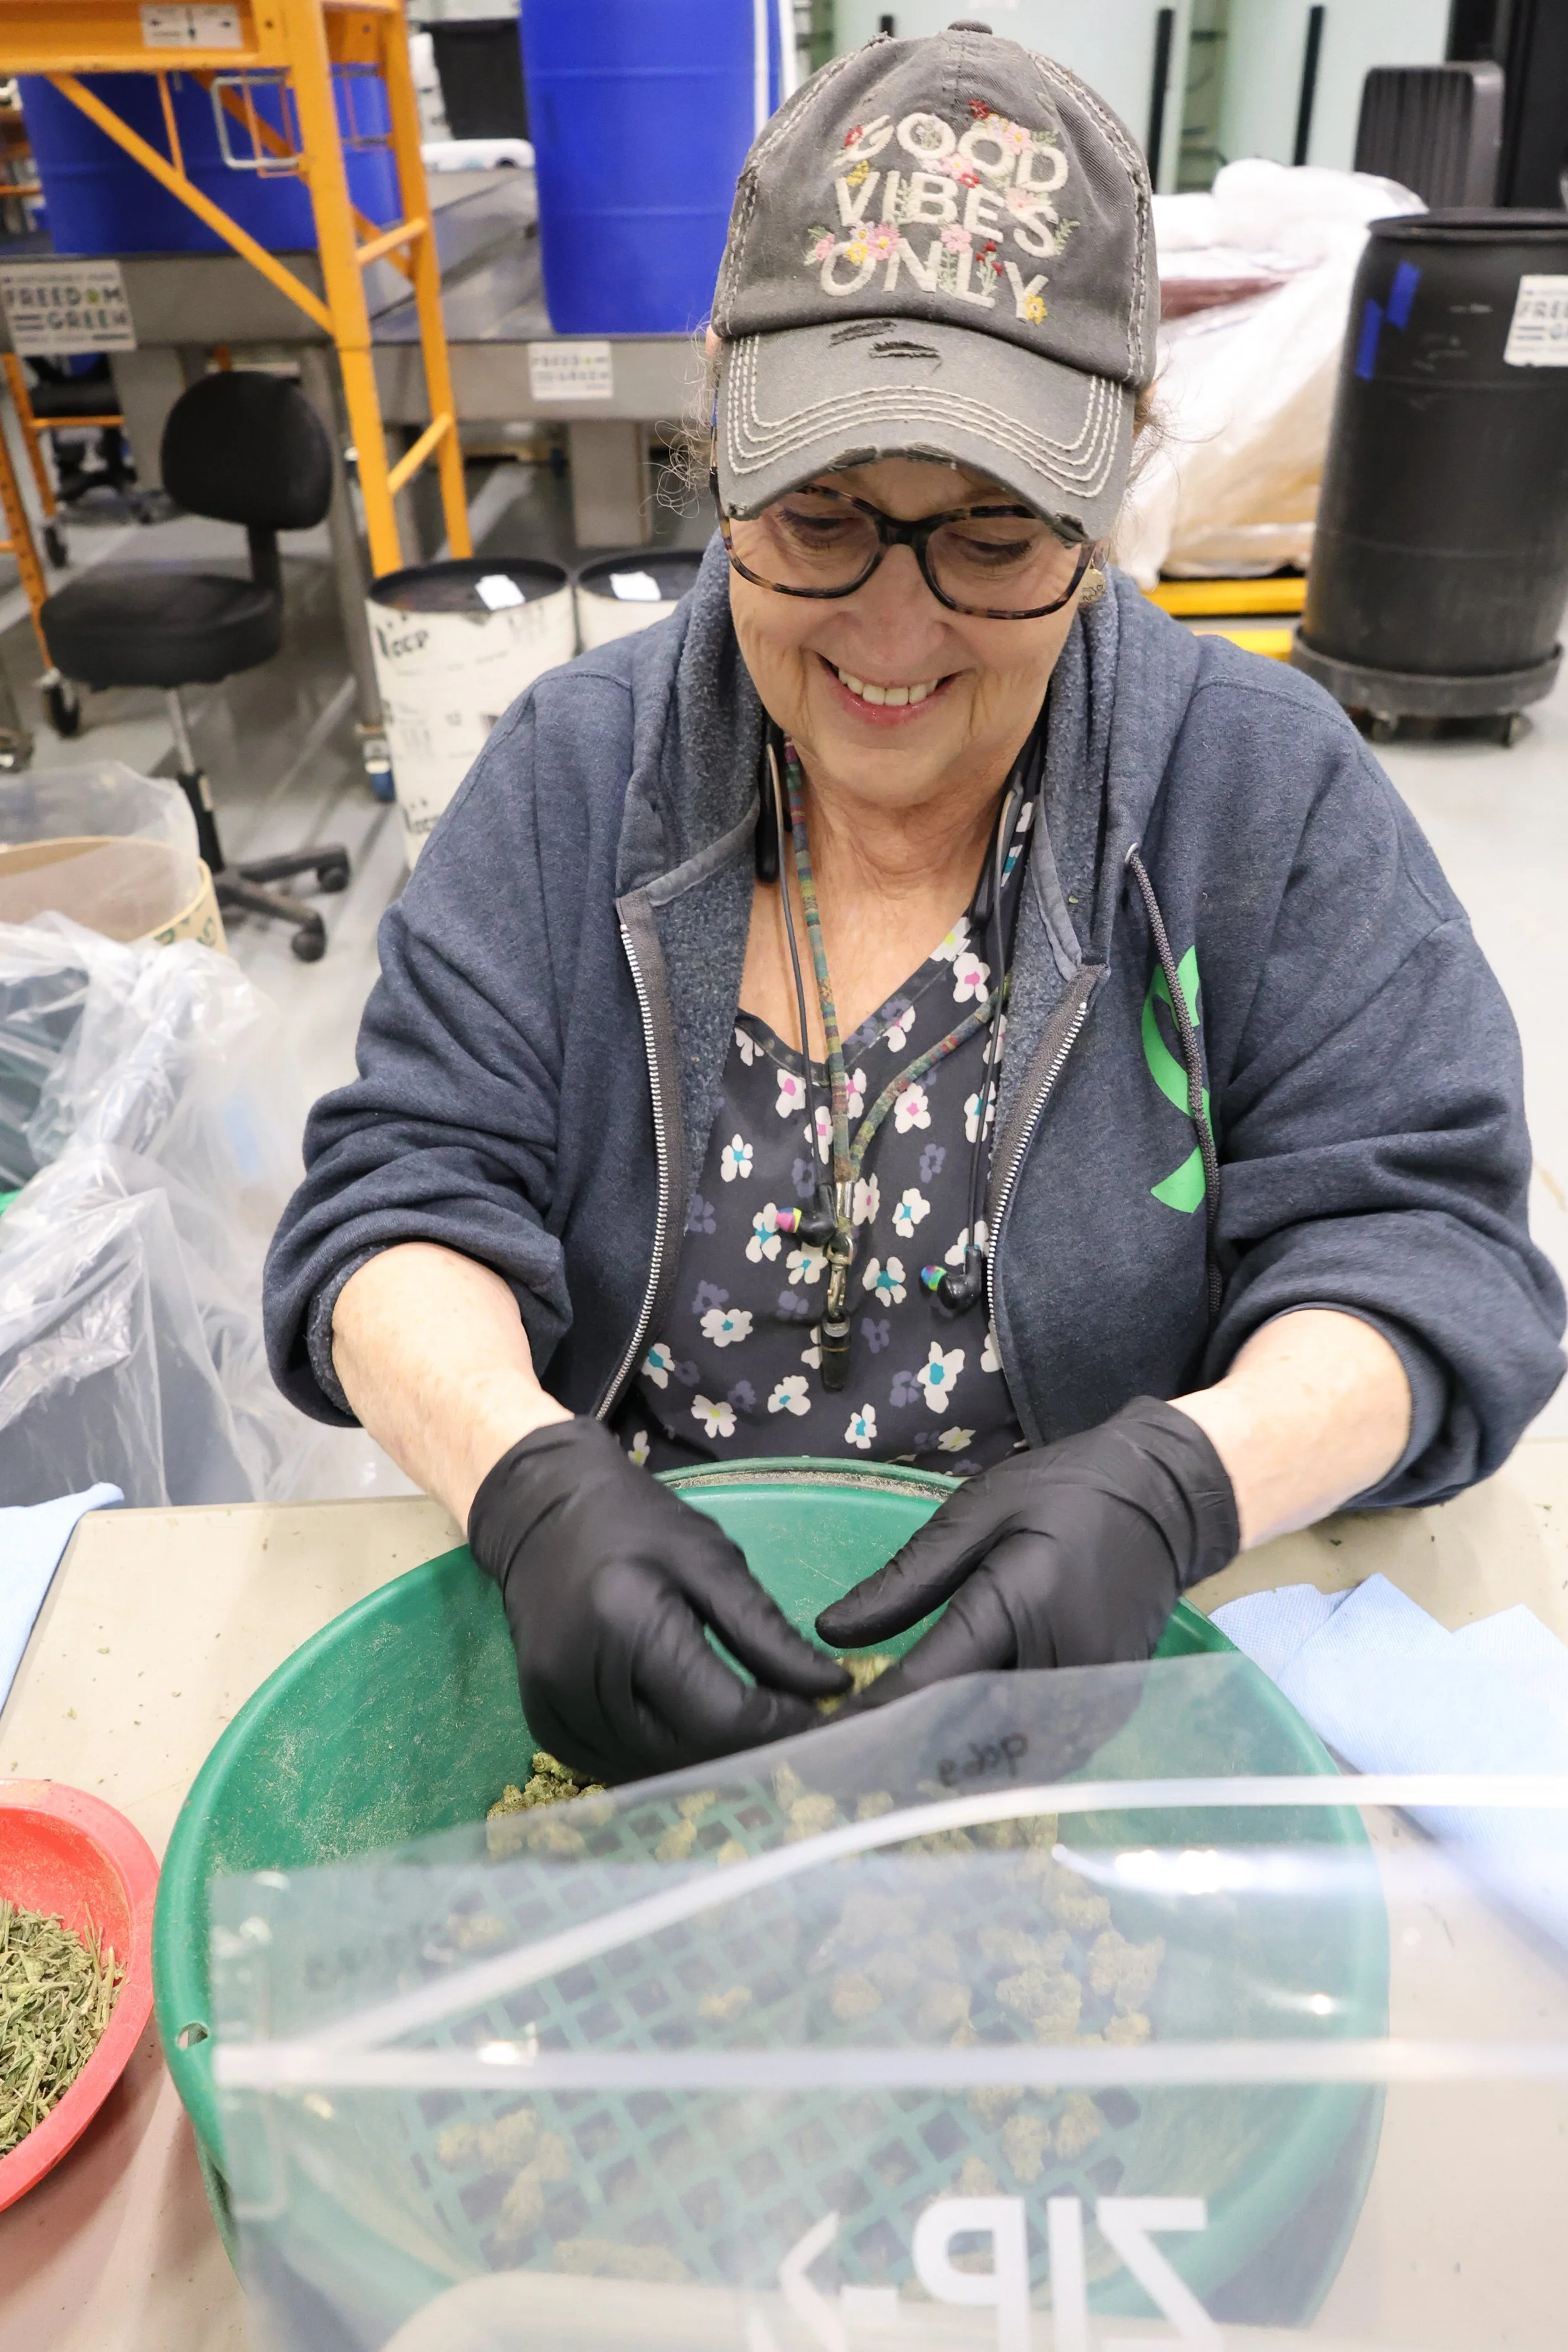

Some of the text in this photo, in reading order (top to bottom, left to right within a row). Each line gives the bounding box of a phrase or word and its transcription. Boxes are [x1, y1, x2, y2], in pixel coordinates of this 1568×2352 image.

[833, 112, 1068, 192] GOOD
[835, 170, 1058, 258] VIBES
[820, 237, 1049, 322] ONLY
